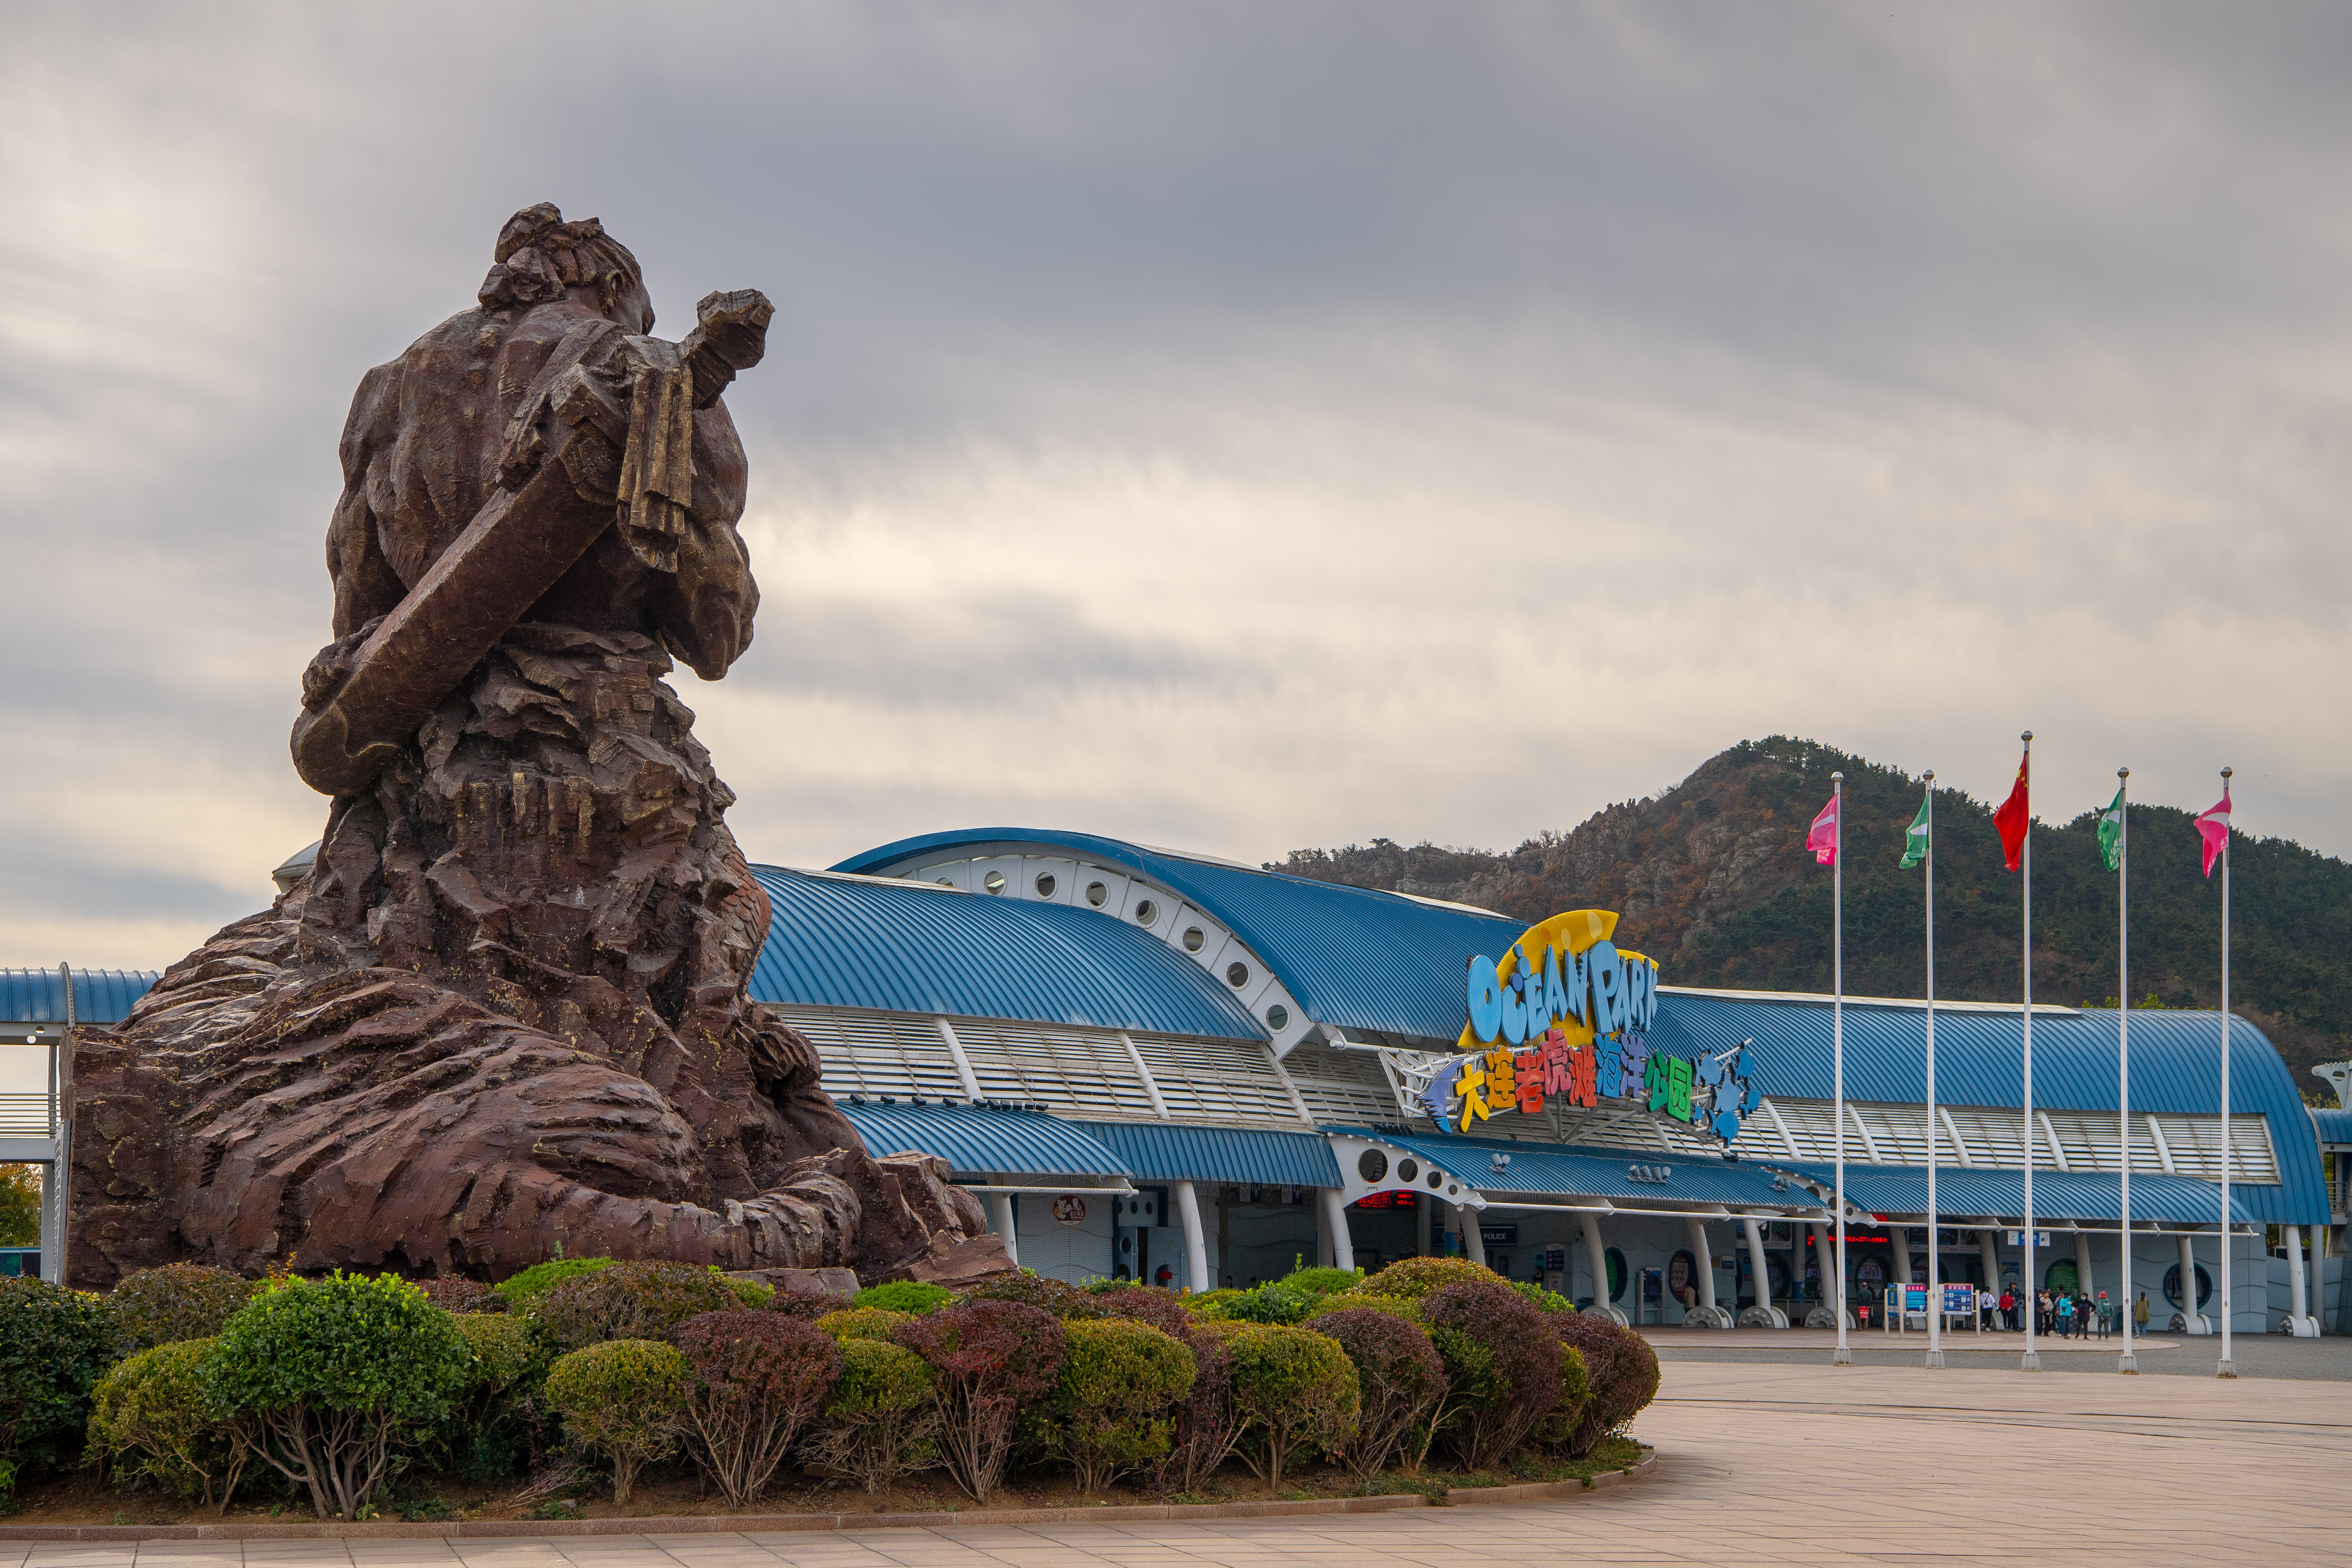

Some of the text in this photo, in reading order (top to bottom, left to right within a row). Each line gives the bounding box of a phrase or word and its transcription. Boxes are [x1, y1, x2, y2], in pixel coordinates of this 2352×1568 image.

[1466, 939, 1658, 1045] OCEAN PARK
[1455, 1028, 1693, 1133] 大连老虎滩海洋公园
